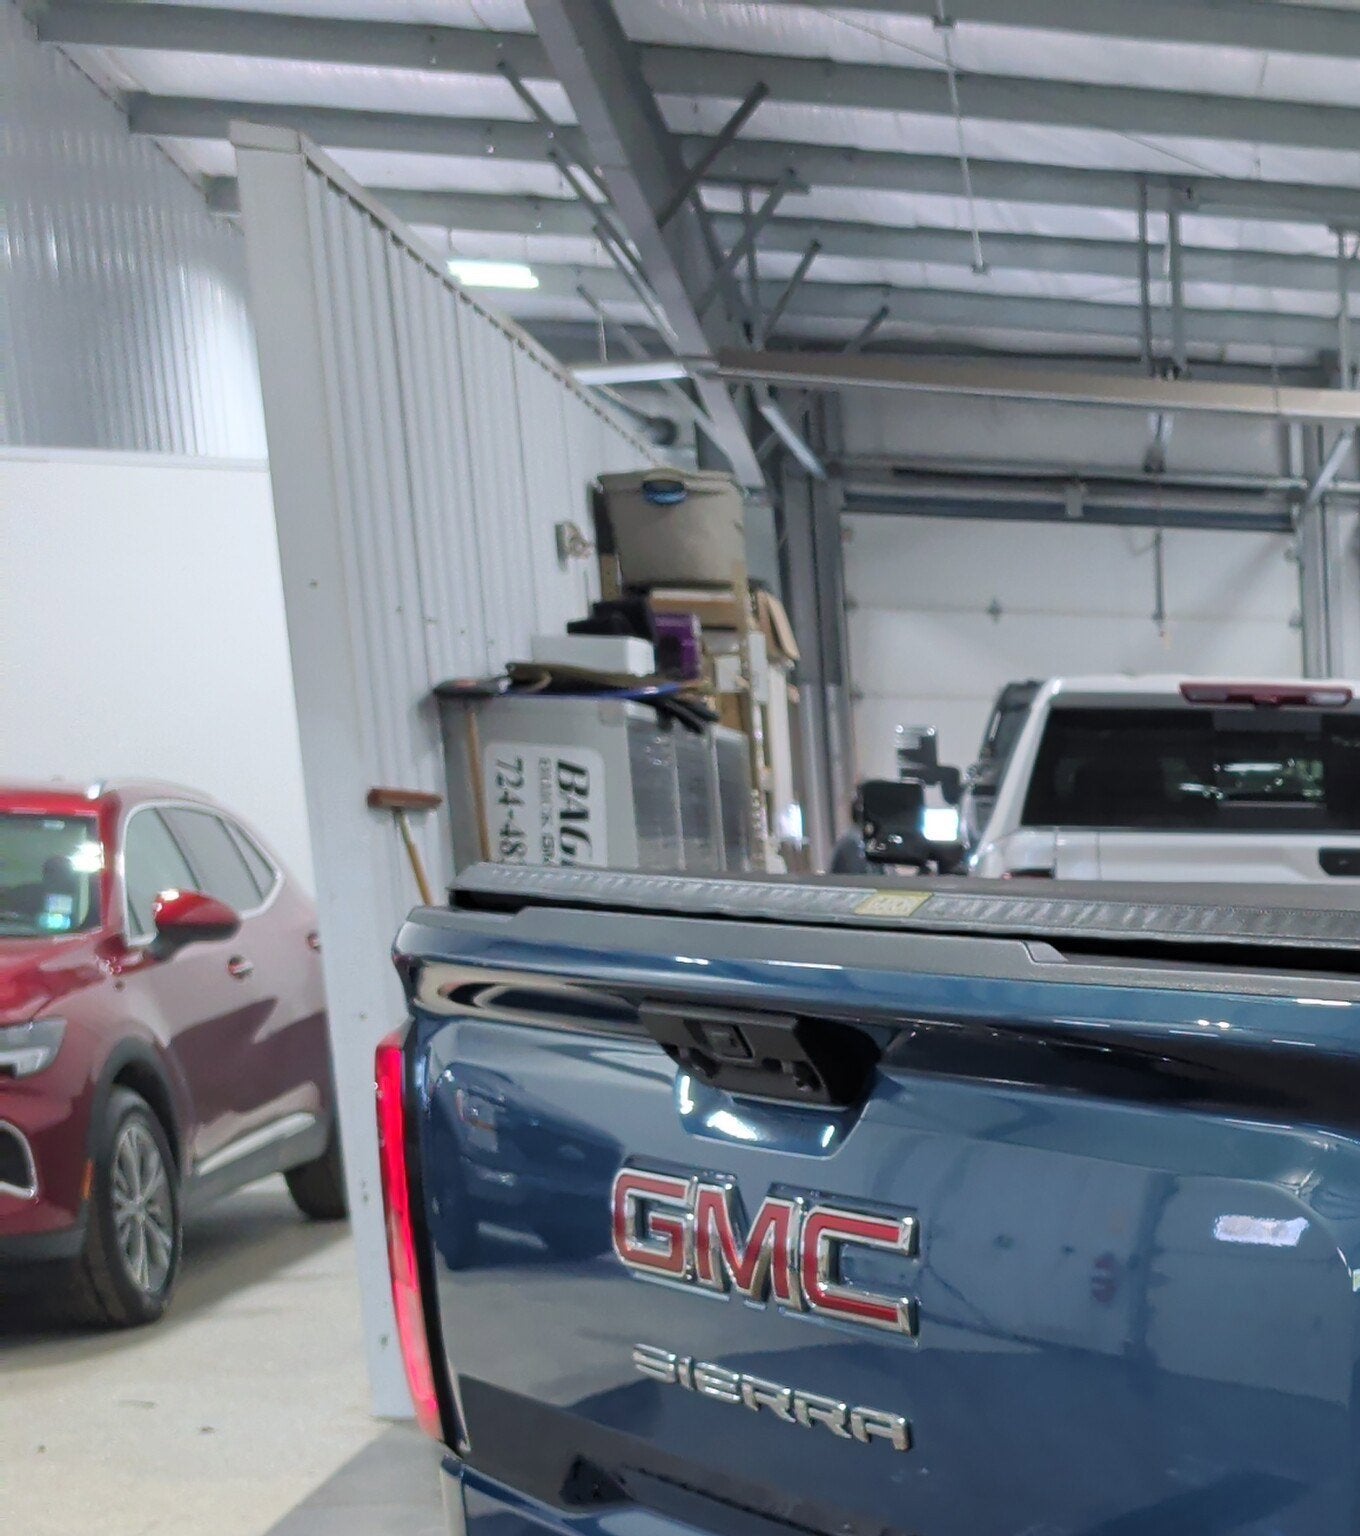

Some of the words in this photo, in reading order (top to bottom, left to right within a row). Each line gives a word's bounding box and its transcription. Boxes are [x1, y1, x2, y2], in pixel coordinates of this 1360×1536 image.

[495, 755, 528, 866] 724-48
[557, 758, 593, 867] BAG
[611, 1156, 920, 1338] GMC
[632, 1343, 914, 1452] SIERRA
